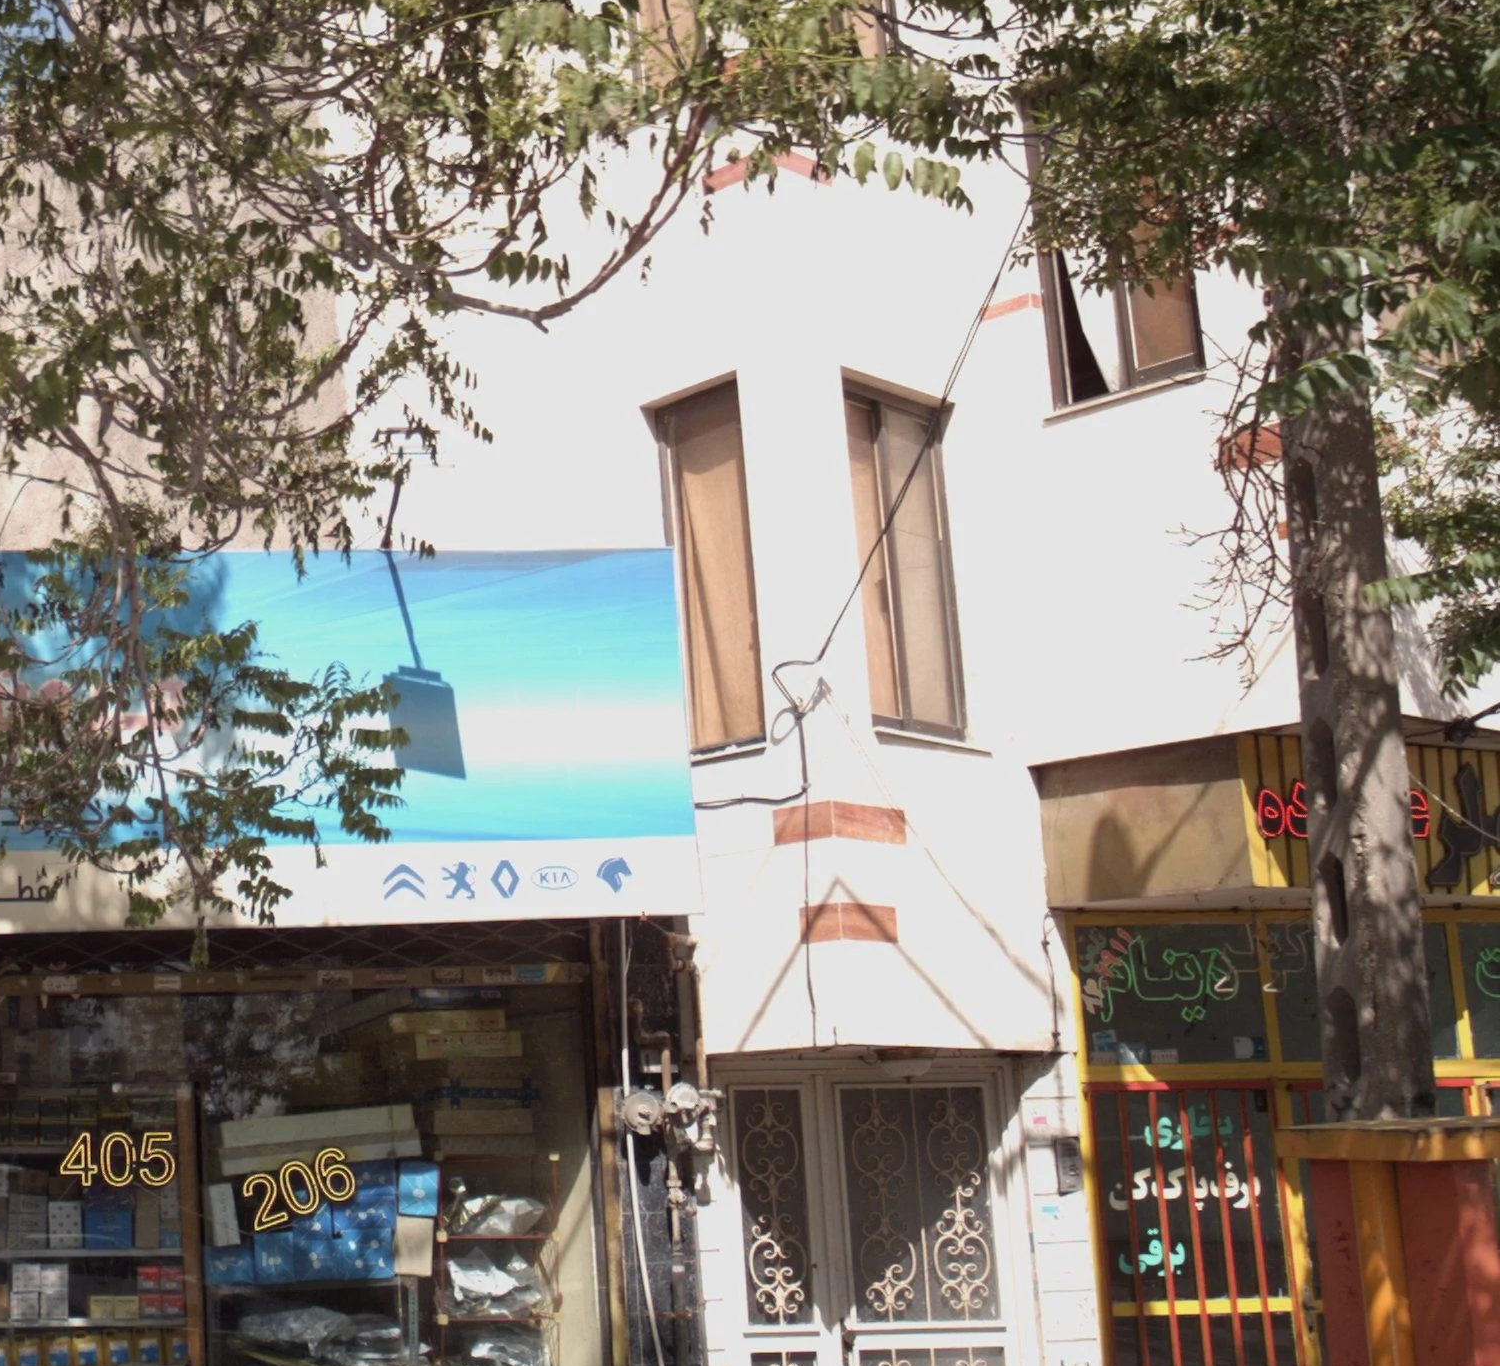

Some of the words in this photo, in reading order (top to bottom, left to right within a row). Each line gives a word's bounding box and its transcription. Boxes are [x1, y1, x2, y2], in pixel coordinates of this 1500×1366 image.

[58, 1131, 176, 1187] 405
[242, 1146, 357, 1232] 206
[1118, 1227, 1186, 1277] برقی
